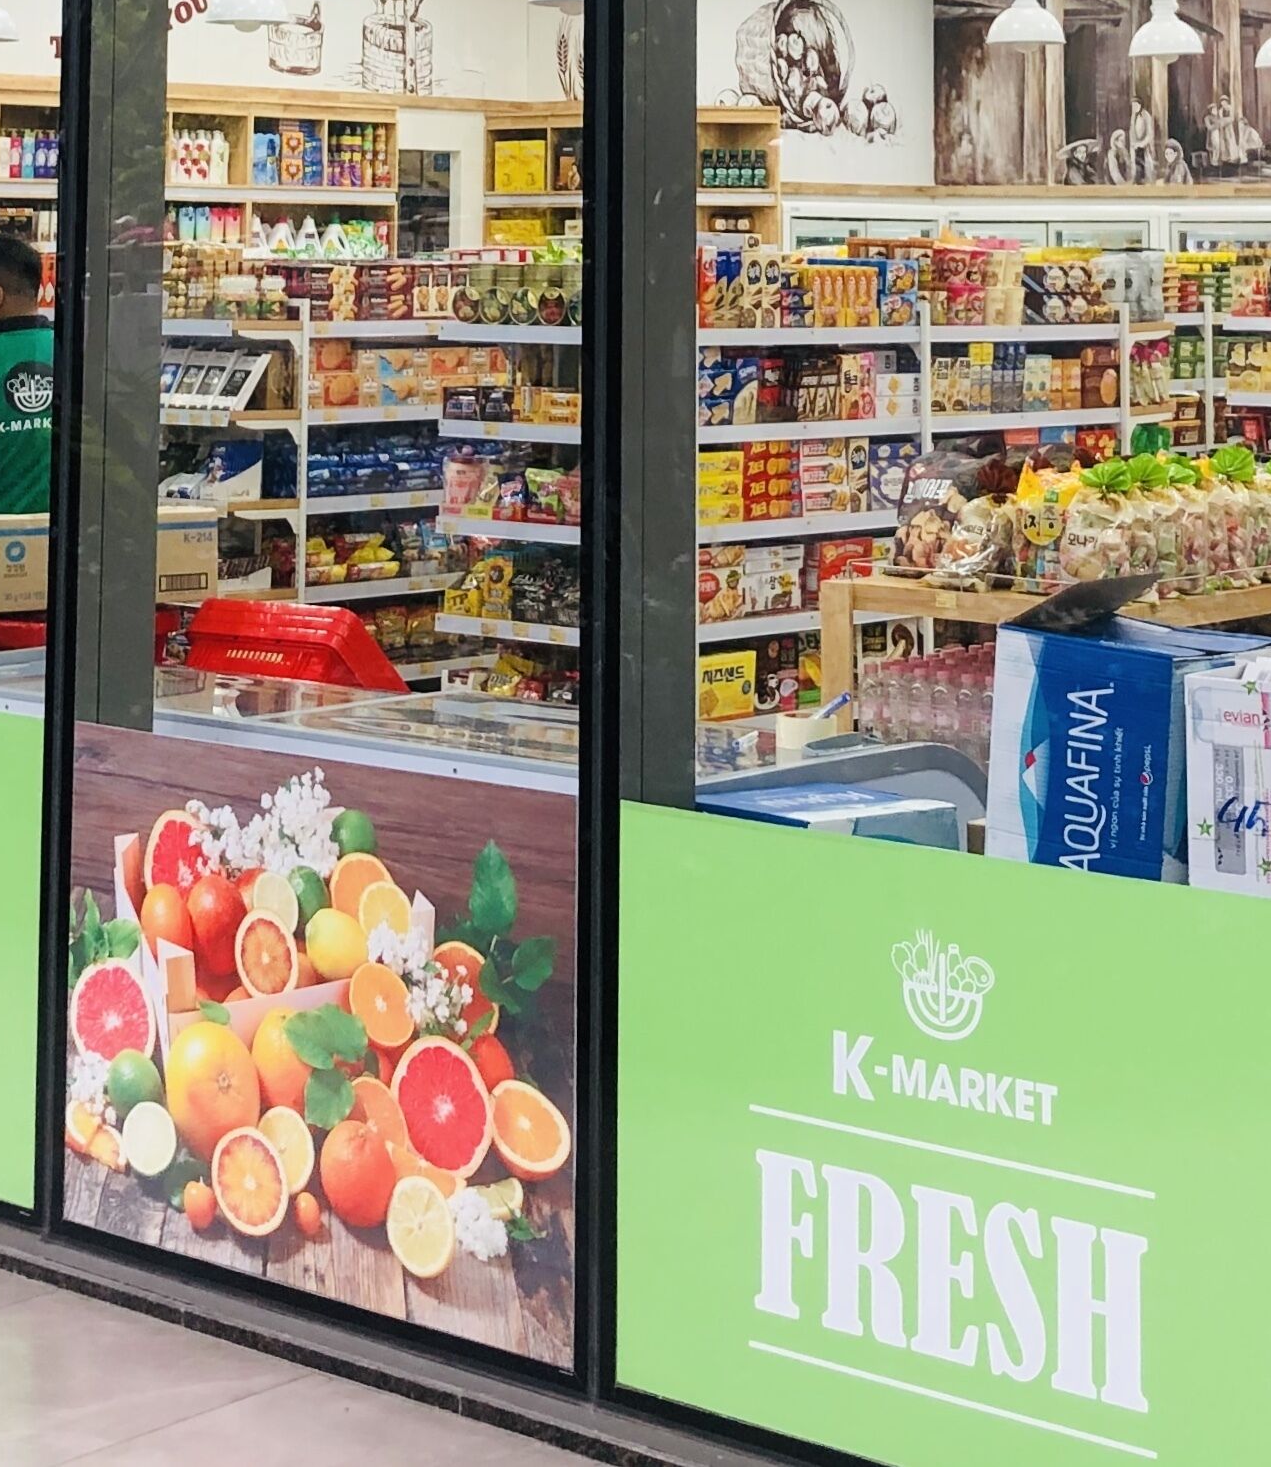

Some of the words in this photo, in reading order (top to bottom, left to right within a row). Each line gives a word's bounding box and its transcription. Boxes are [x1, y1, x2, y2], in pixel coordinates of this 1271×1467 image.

[1059, 687, 1115, 870] AQUAFINA
[1223, 709, 1261, 727] evian
[831, 1028, 1059, 1126] K-MARKET
[753, 1147, 1149, 1414] FRESH
